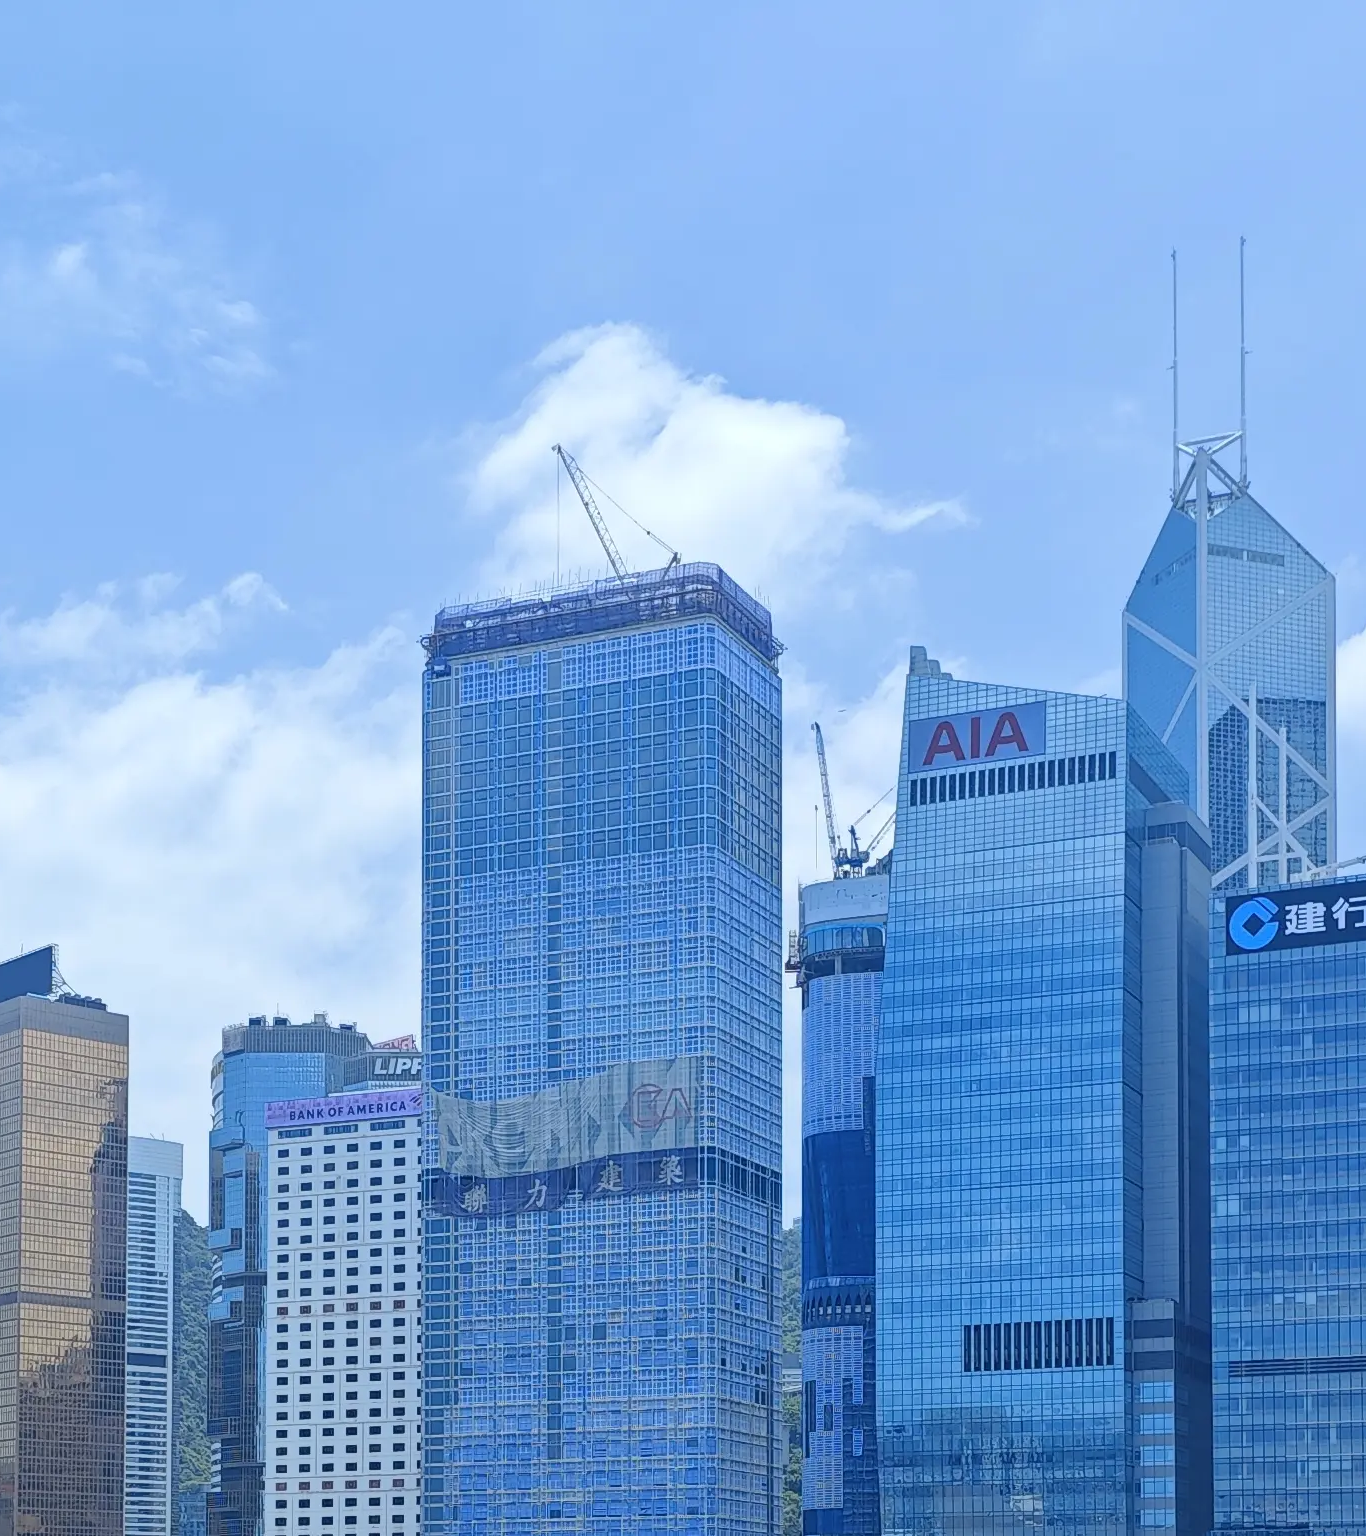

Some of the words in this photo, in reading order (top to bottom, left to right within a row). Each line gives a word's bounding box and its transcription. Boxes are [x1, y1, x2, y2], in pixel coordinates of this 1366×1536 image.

[922, 711, 1029, 766] AIA
[289, 1108, 325, 1121] BANK
[328, 1106, 345, 1118] OF
[346, 1100, 407, 1116] AMERICA
